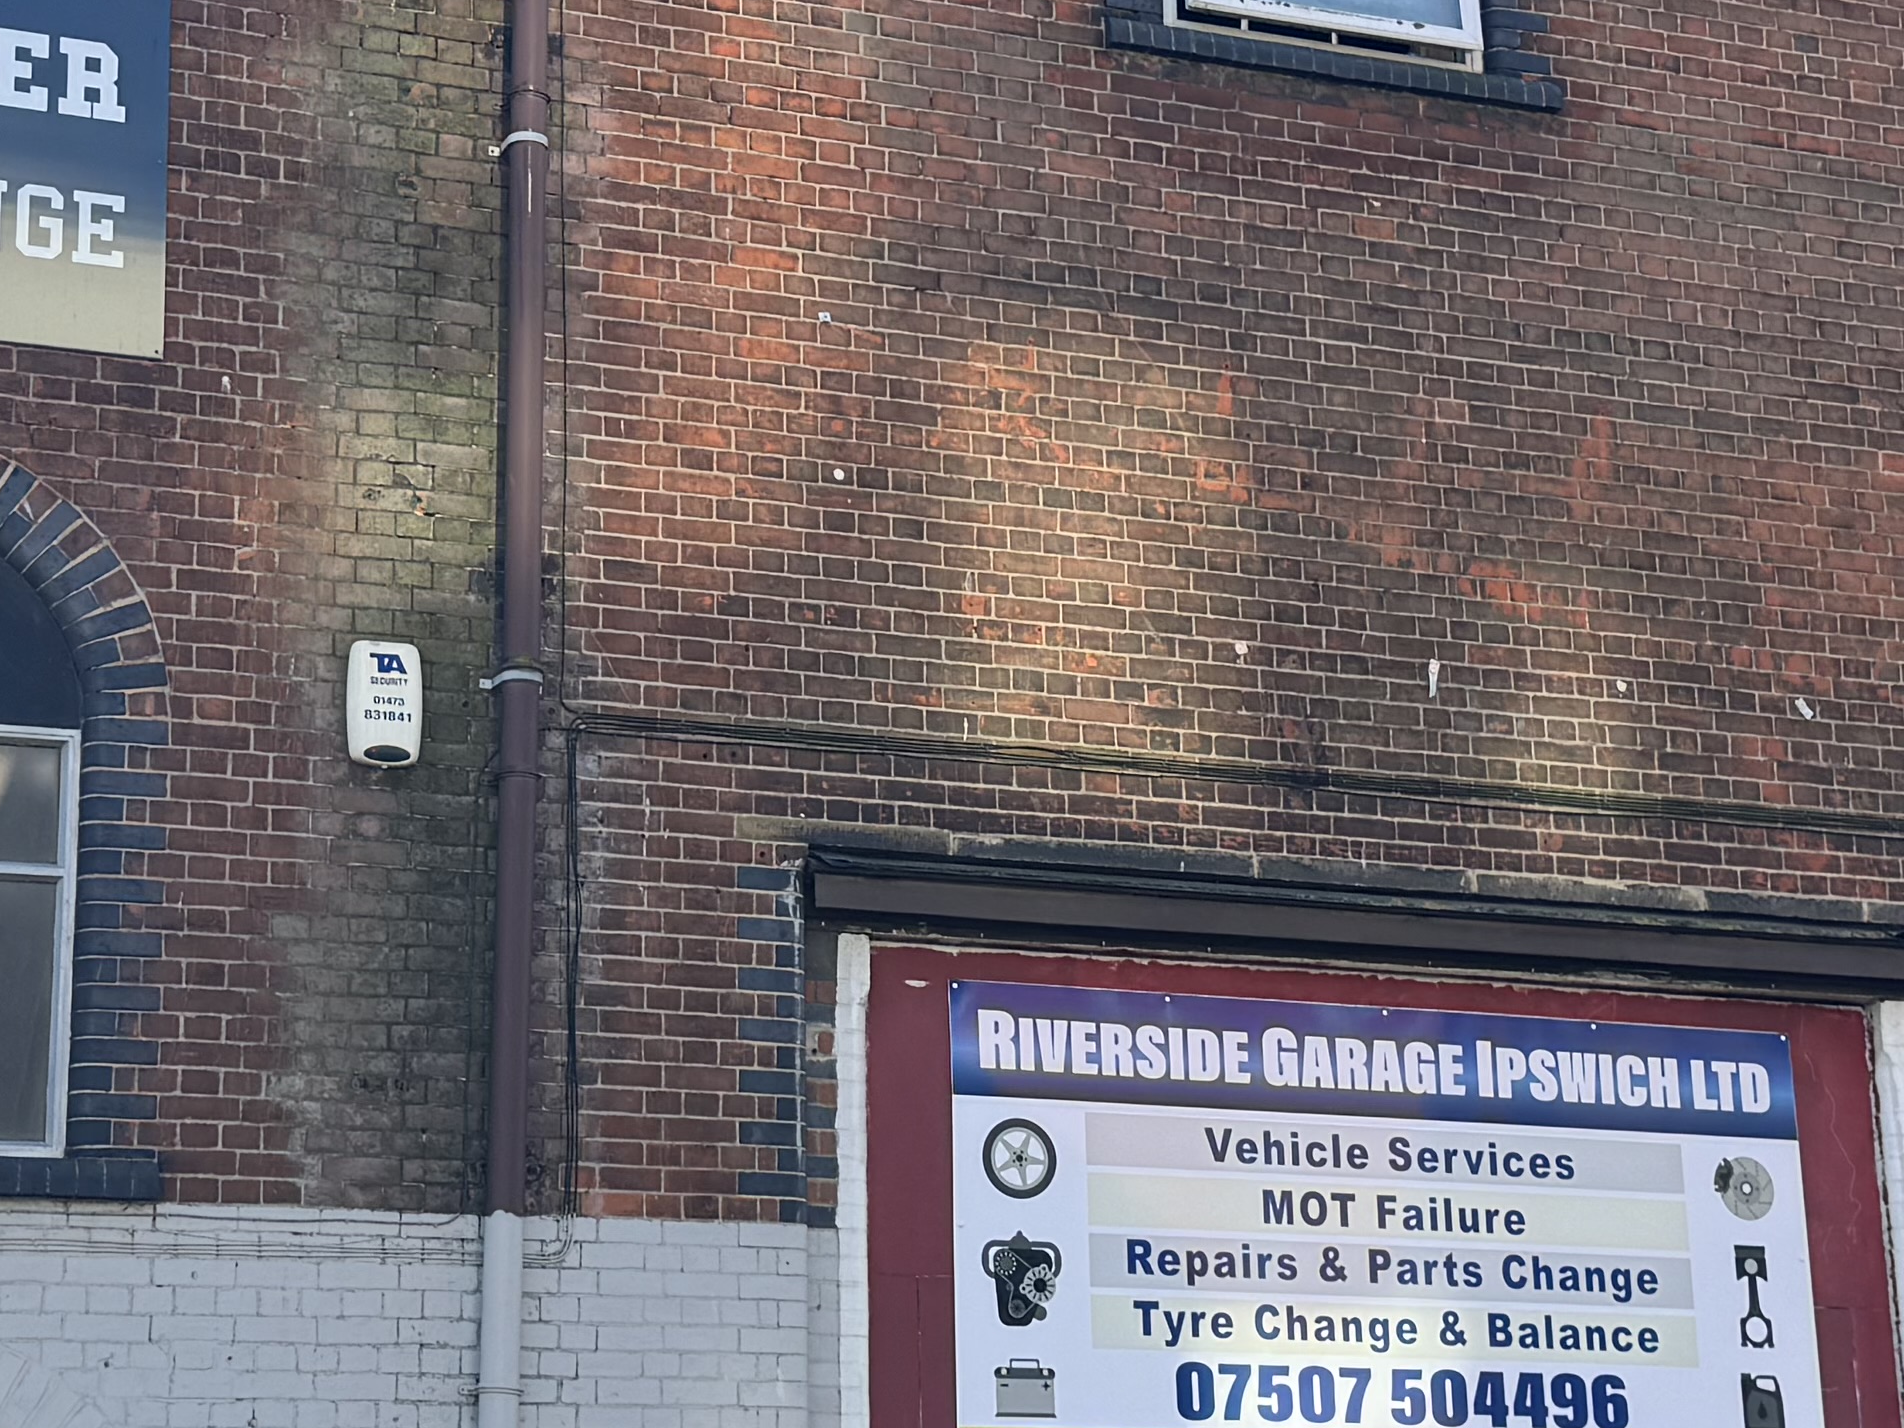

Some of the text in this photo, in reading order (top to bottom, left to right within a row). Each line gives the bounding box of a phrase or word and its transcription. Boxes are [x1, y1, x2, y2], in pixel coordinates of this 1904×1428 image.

[369, 652, 408, 675] TA
[370, 676, 408, 687] SECURITY
[364, 709, 412, 723] 831841
[373, 696, 405, 707] 01473
[977, 1008, 1771, 1114] RIVERSIDE GARAGE IPSWICH LTD
[1204, 1127, 1576, 1181] Vehicle Services
[1262, 1188, 1527, 1236] MOT Failure
[1126, 1238, 1659, 1303] Repairs & Parts Change
[1133, 1300, 1660, 1353] Tyre Change & Balance
[1175, 1361, 1372, 1423] 07507
